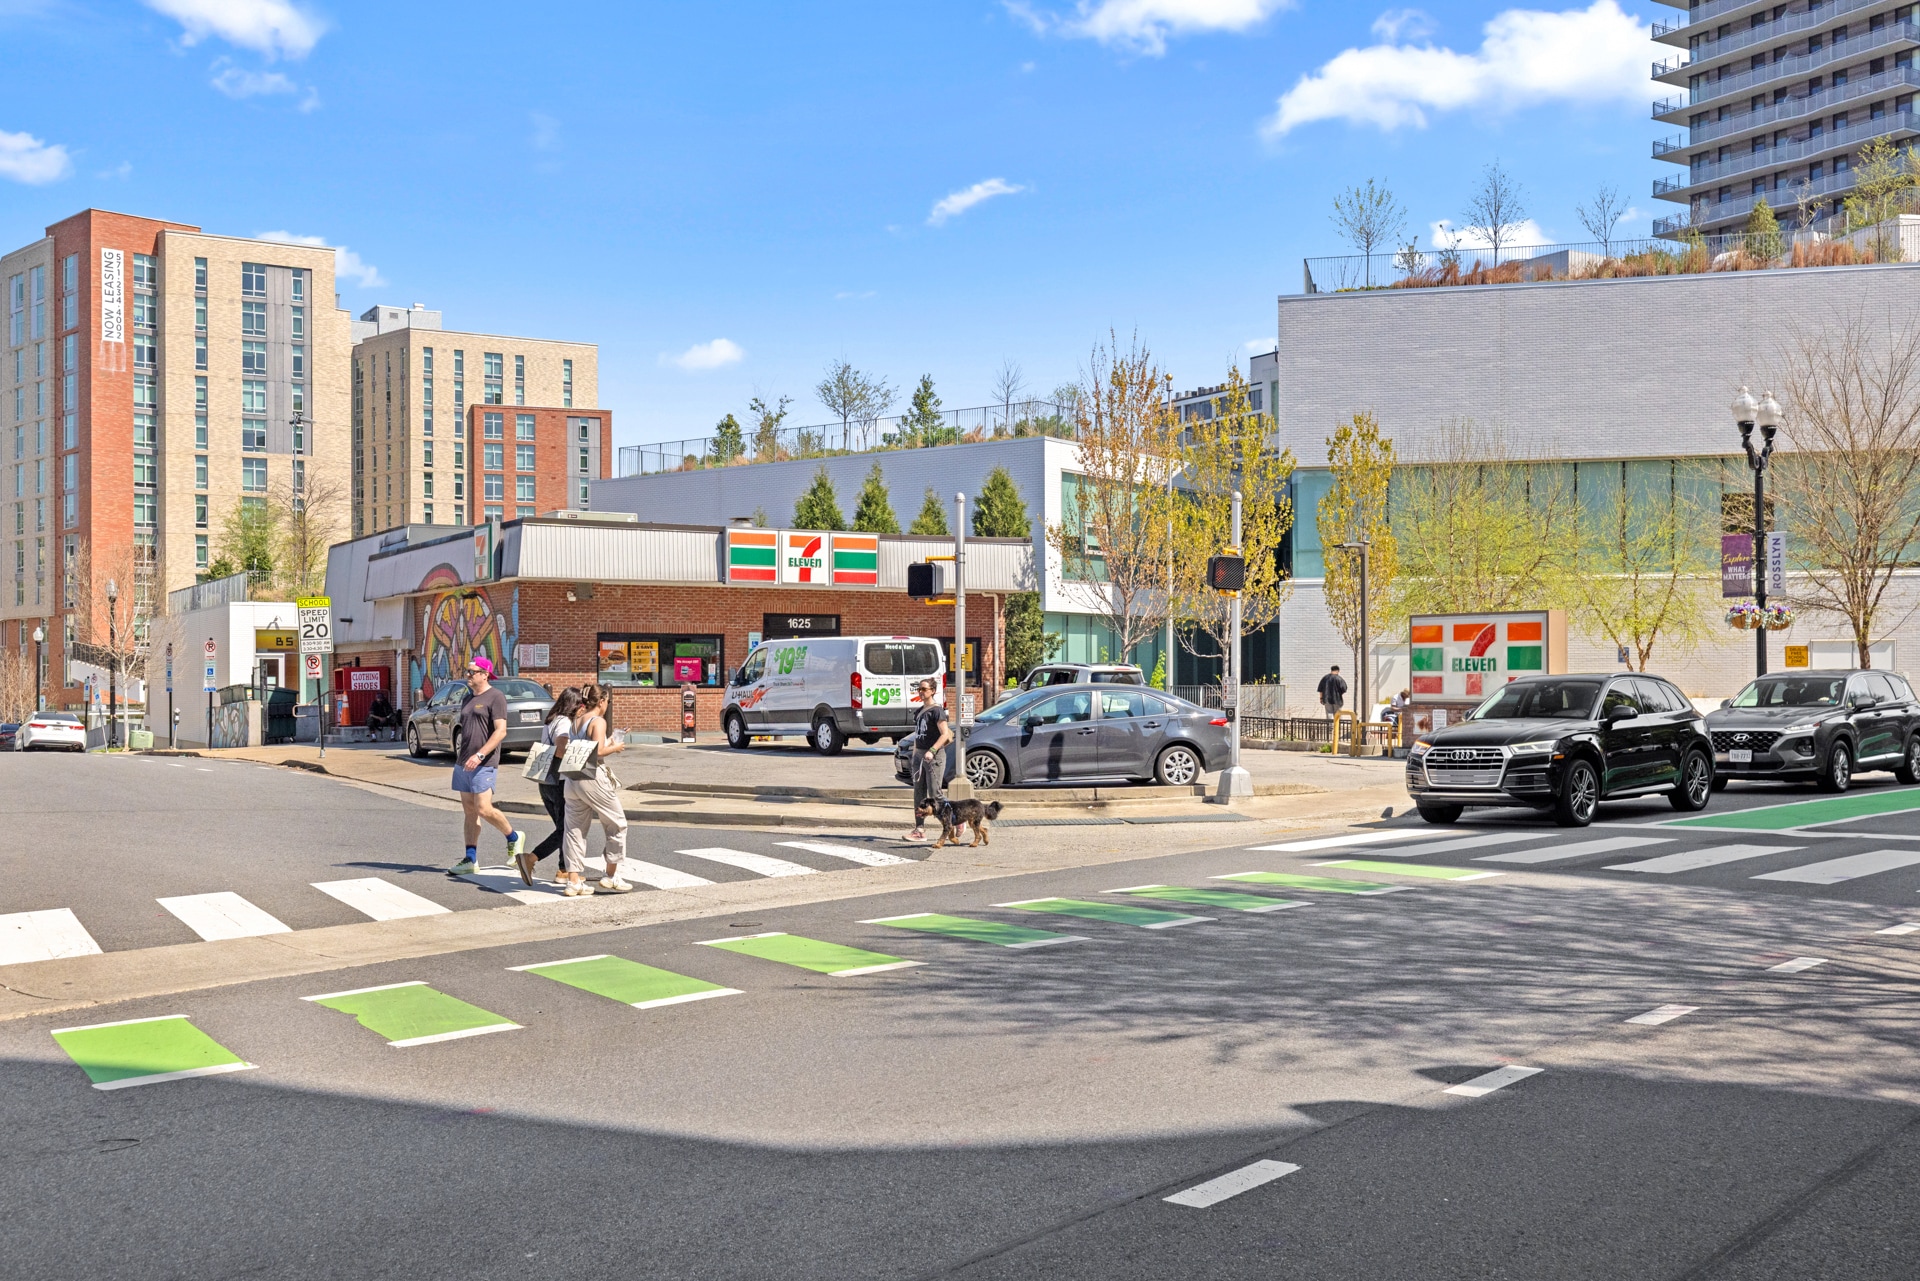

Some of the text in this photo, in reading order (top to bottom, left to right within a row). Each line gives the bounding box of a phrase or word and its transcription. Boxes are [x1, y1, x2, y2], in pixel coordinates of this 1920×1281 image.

[103, 251, 115, 339] NOW LEASING
[789, 535, 822, 582] 7
[1722, 553, 1750, 565] Explore
[1772, 537, 1782, 589] ROSSLYN
[299, 599, 328, 607] SCHOOL
[300, 609, 328, 617] SPEED
[787, 618, 811, 629] 1625
[302, 623, 328, 638] 20
[690, 646, 712, 654] ATM
[1453, 623, 1496, 695] 7
[352, 672, 379, 681] CLOTHING
